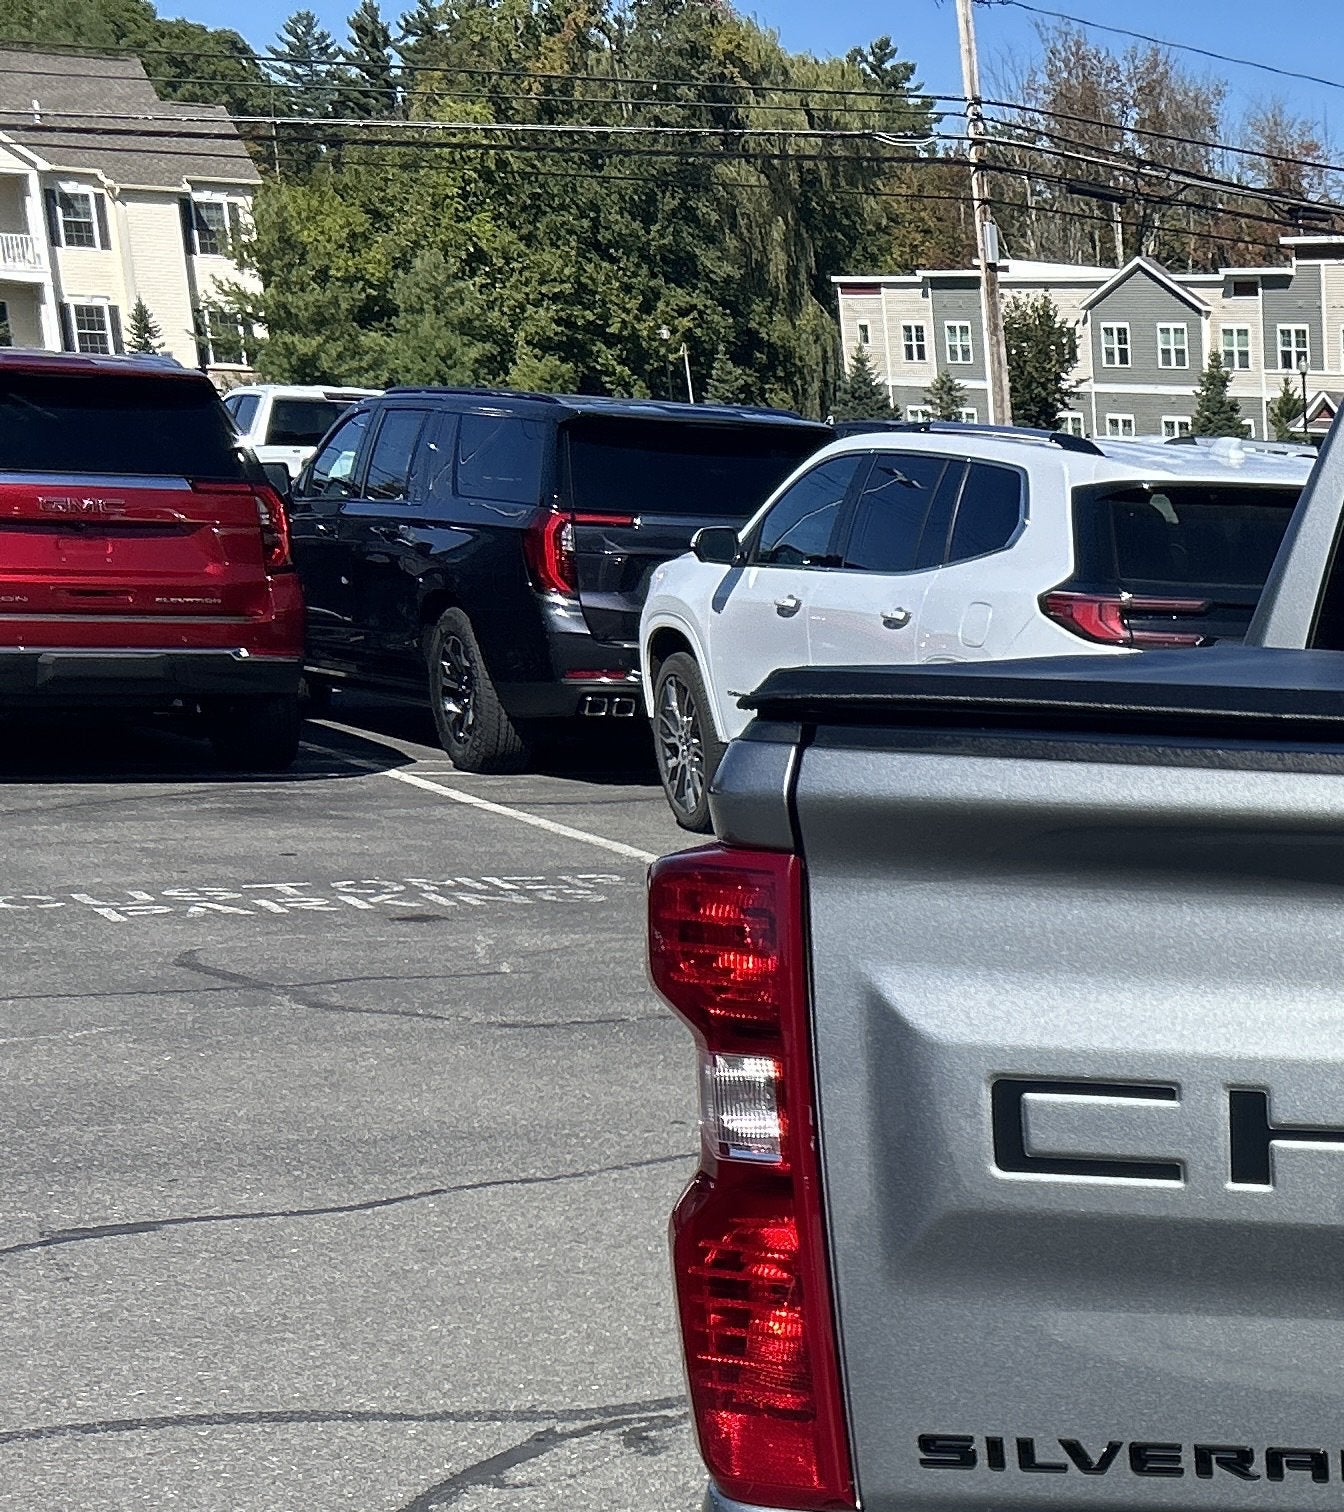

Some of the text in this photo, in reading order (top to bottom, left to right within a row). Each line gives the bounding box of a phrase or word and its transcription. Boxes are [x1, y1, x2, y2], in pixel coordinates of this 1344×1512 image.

[37, 495, 126, 513] GMC
[0, 874, 638, 909] CUSTOMER
[92, 890, 609, 922] PARKING
